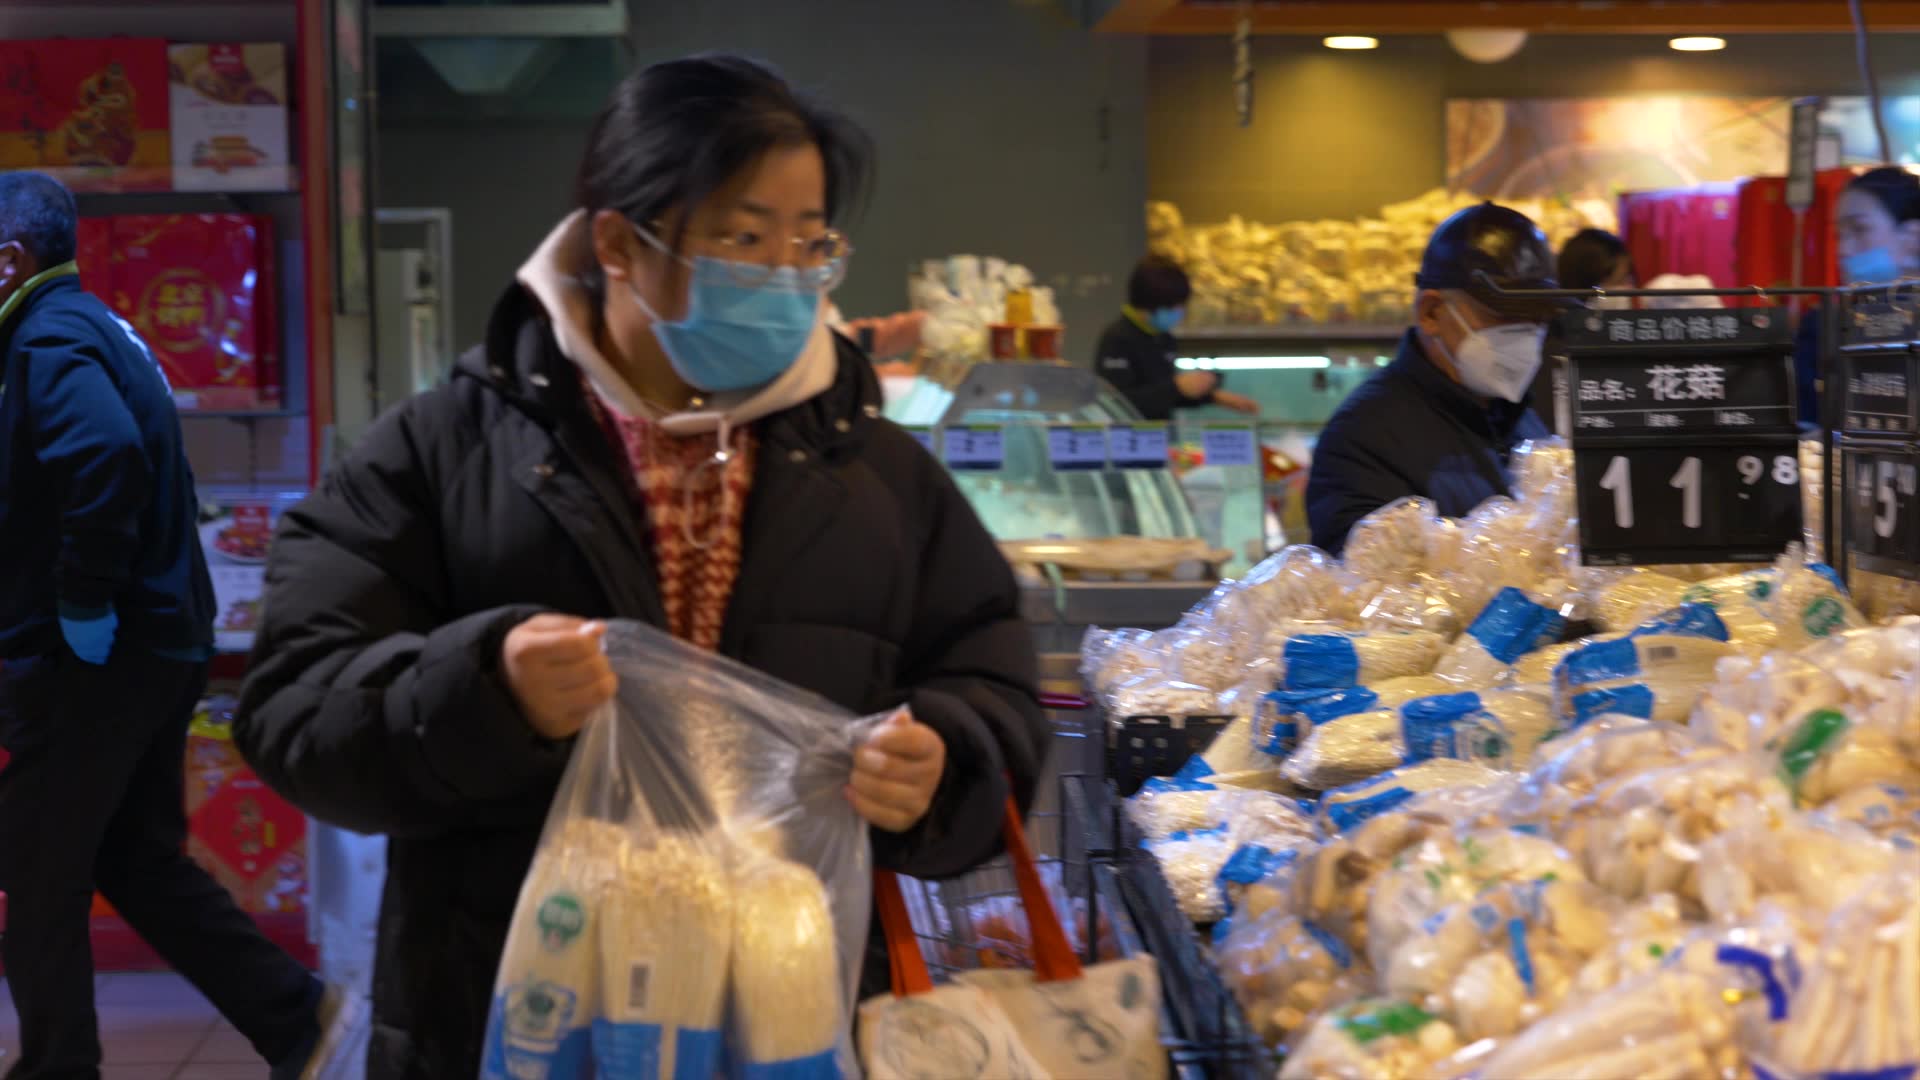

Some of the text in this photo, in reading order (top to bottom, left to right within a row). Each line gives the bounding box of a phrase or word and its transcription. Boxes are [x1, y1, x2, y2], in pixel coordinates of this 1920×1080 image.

[1608, 315, 1739, 341] 商品价格牌
[1645, 364, 1725, 401] 花菇
